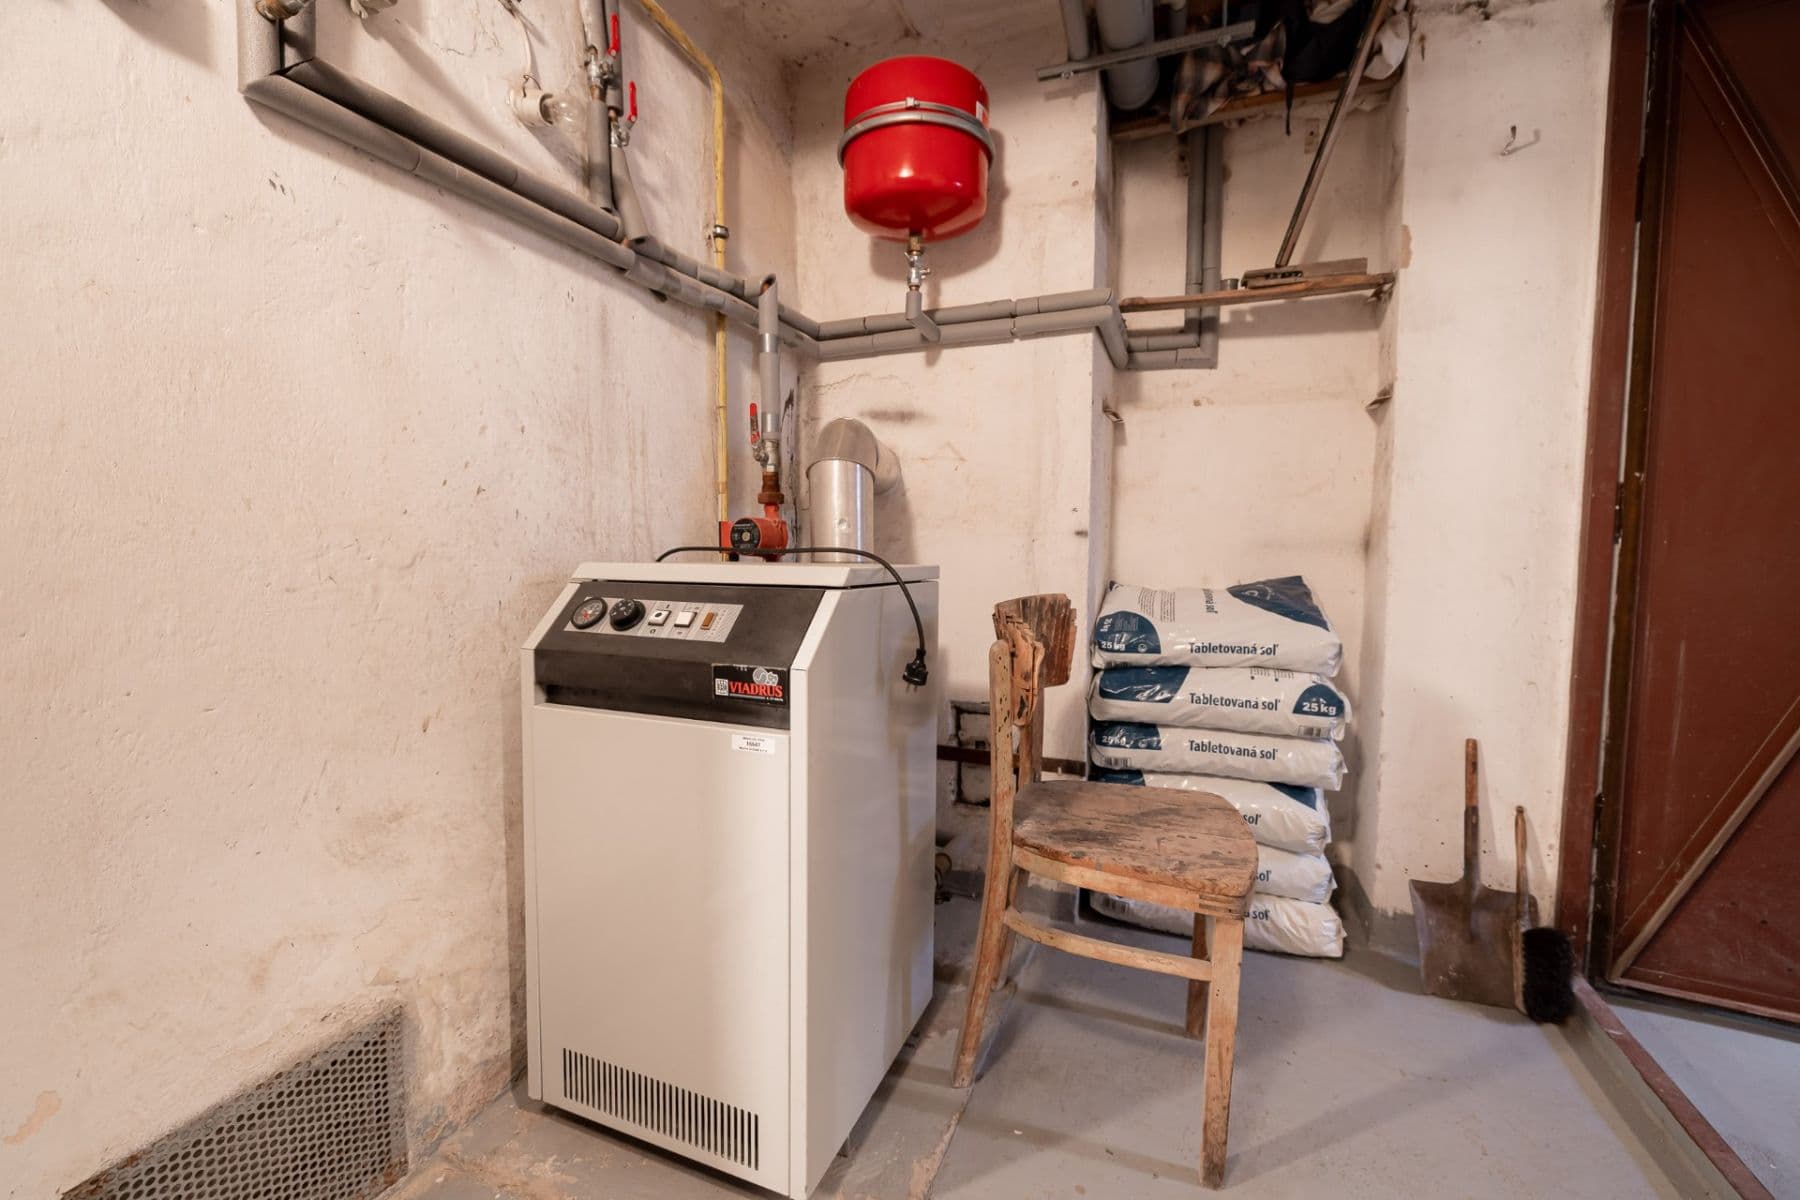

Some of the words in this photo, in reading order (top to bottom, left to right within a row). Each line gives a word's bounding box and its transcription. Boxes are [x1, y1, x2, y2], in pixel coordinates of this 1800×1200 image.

[1188, 642, 1257, 655] Tabletovaná
[729, 681, 784, 698] VIADRUS
[1189, 692, 1259, 710] Tabletovaná
[1302, 701, 1319, 713] 25
[1320, 702, 1337, 716] kg
[1188, 740, 1257, 758] Tabletovaná
